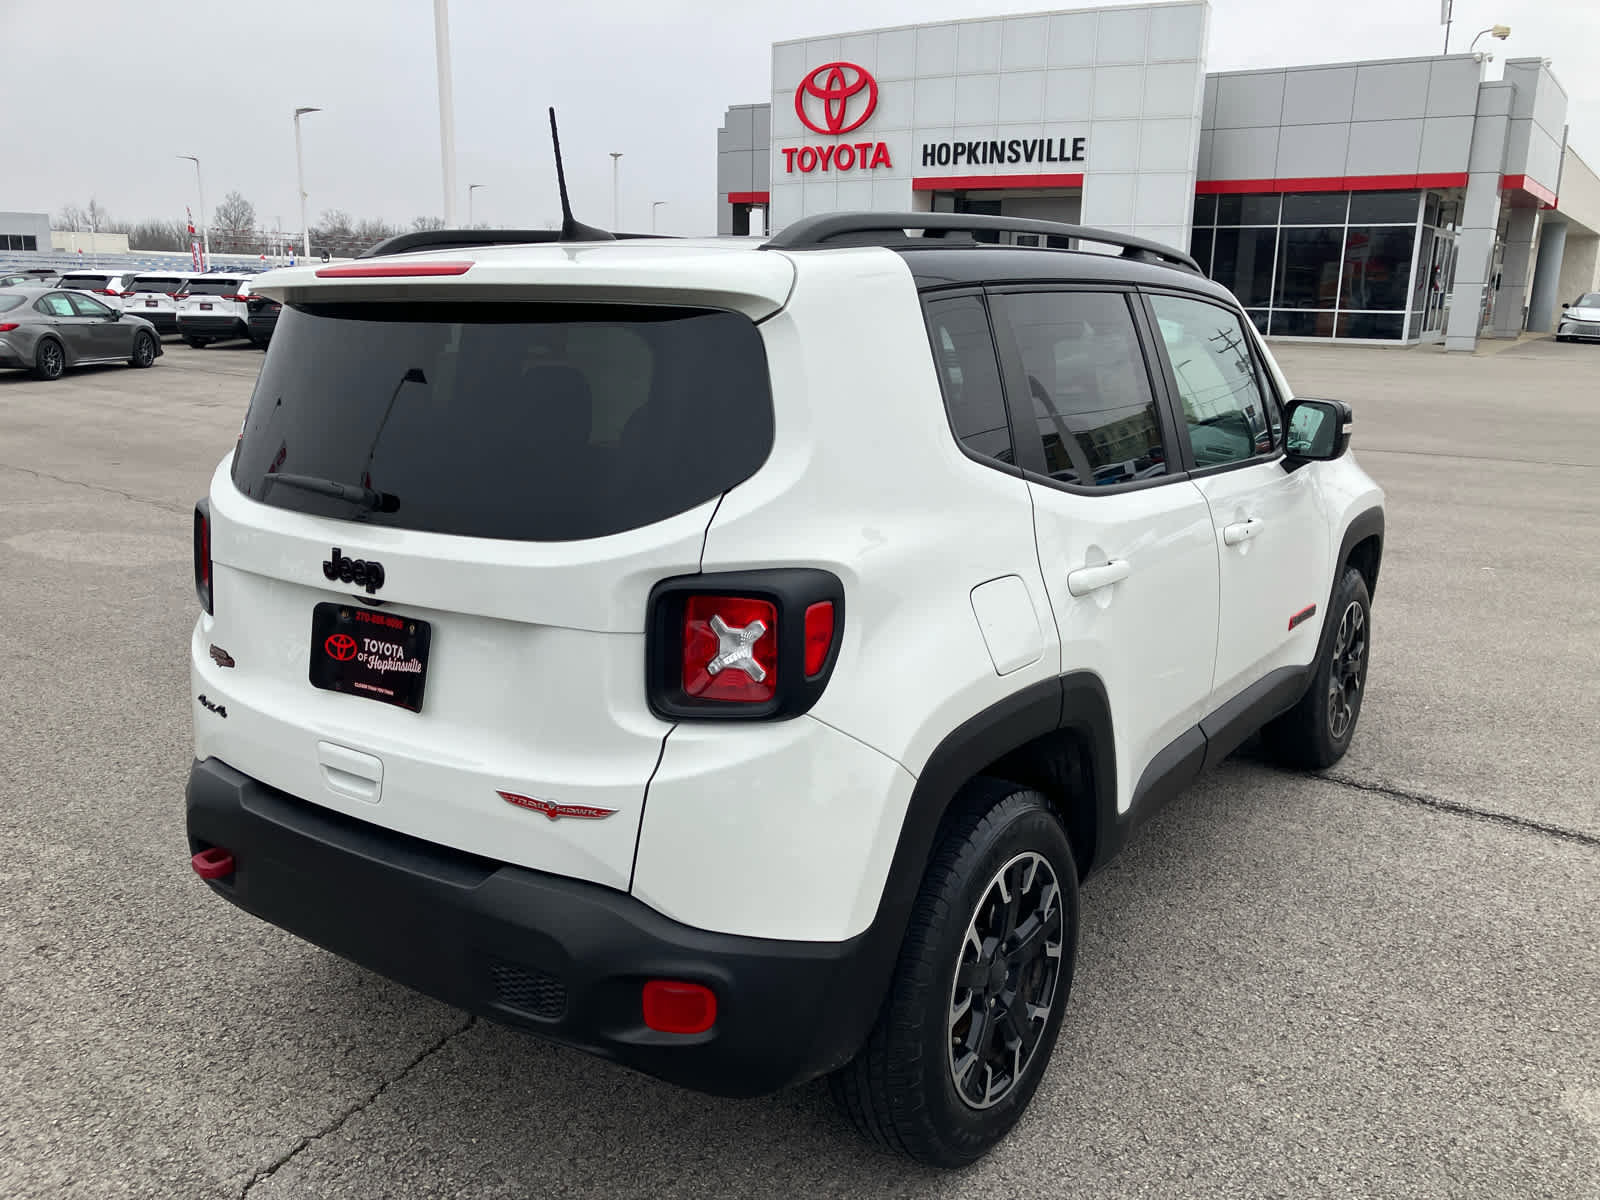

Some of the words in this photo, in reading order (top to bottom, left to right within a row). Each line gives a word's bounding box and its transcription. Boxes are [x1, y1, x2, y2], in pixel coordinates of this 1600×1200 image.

[782, 142, 892, 173] TOYOTA
[922, 137, 1086, 166] HOPKINSVILLE
[322, 547, 385, 594] Jeep
[357, 652, 369, 662] OF
[367, 655, 422, 674] Hopkinsville
[363, 638, 404, 660] TOYOTA
